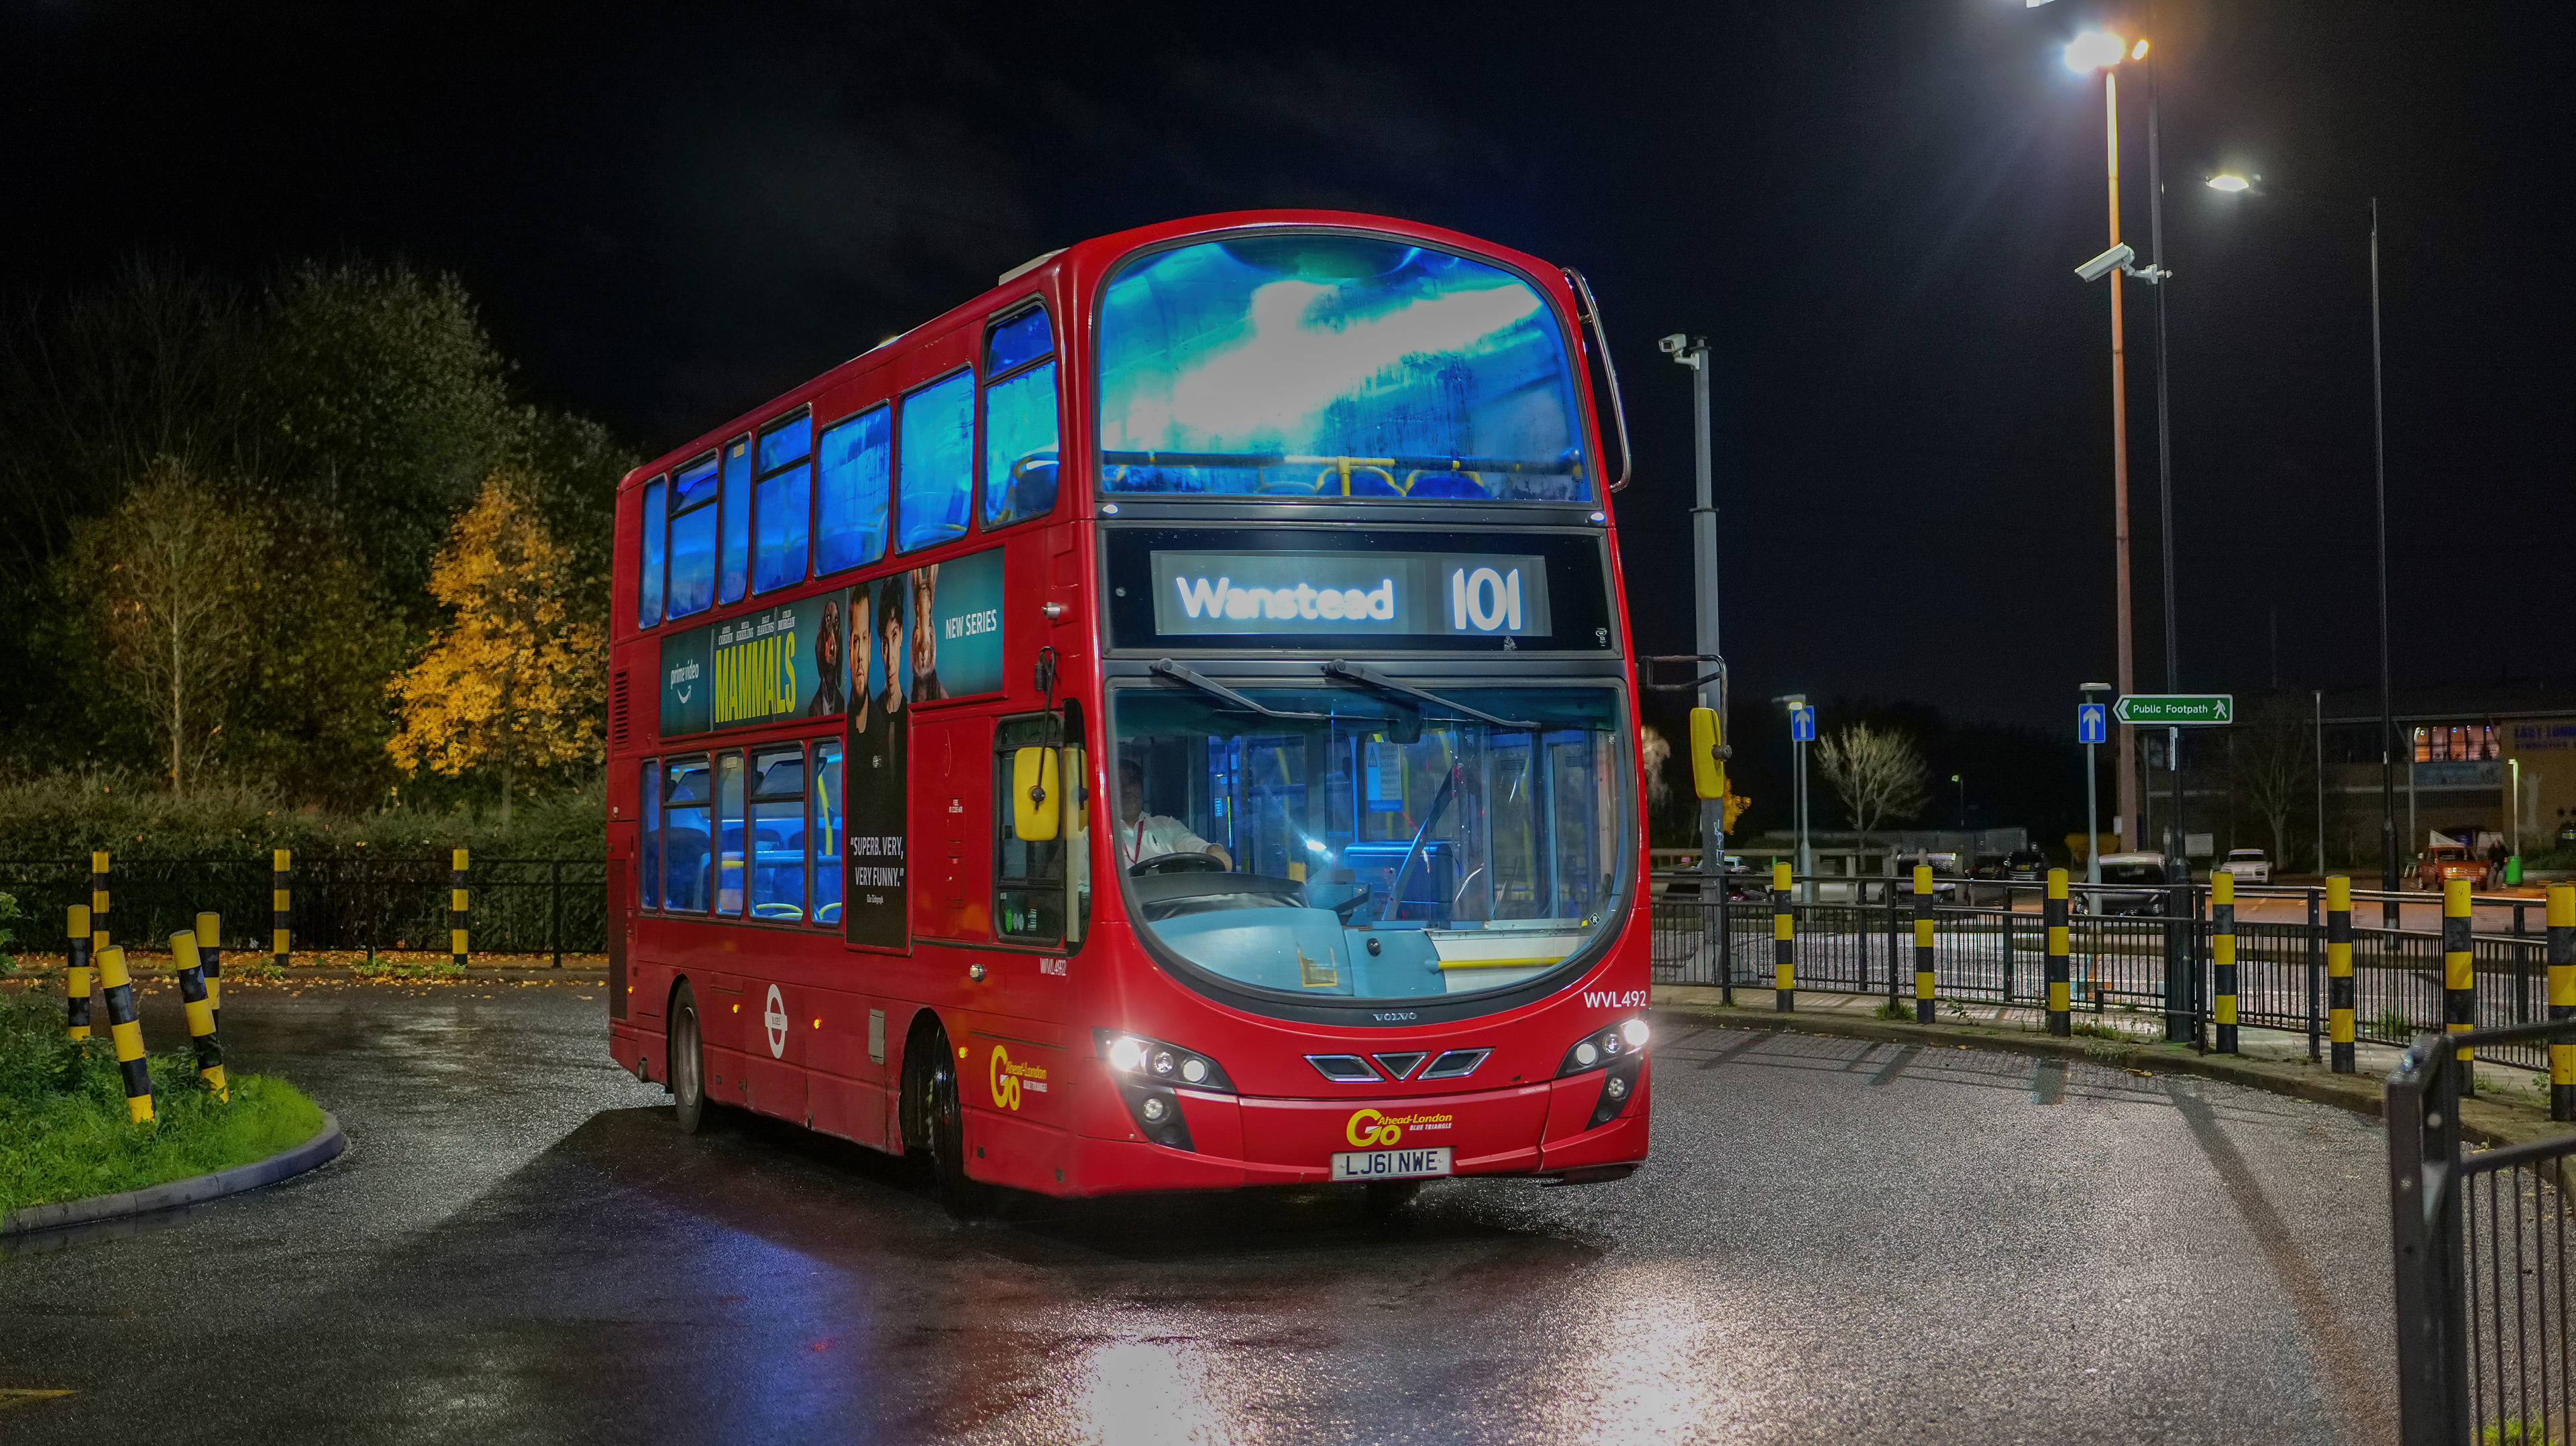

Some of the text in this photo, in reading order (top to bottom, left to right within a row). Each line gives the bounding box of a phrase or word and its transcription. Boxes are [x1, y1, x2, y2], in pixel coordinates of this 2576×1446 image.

[1176, 567, 1521, 631] Wanstead 101
[946, 609, 997, 639] NEW SERIES
[671, 659, 699, 689] prime video
[715, 631, 796, 722] MAMMALS
[2133, 704, 2208, 715] Public Footpath
[882, 836, 904, 860] VERY,
[855, 867, 872, 886] VERY
[1583, 990, 1646, 1008] WVL492
[1373, 1012, 1418, 1021] VOLVO
[990, 1045, 1020, 1111] Go
[1346, 1109, 1401, 1147] Go
[1346, 1150, 1438, 1176] LJ61 NWE
